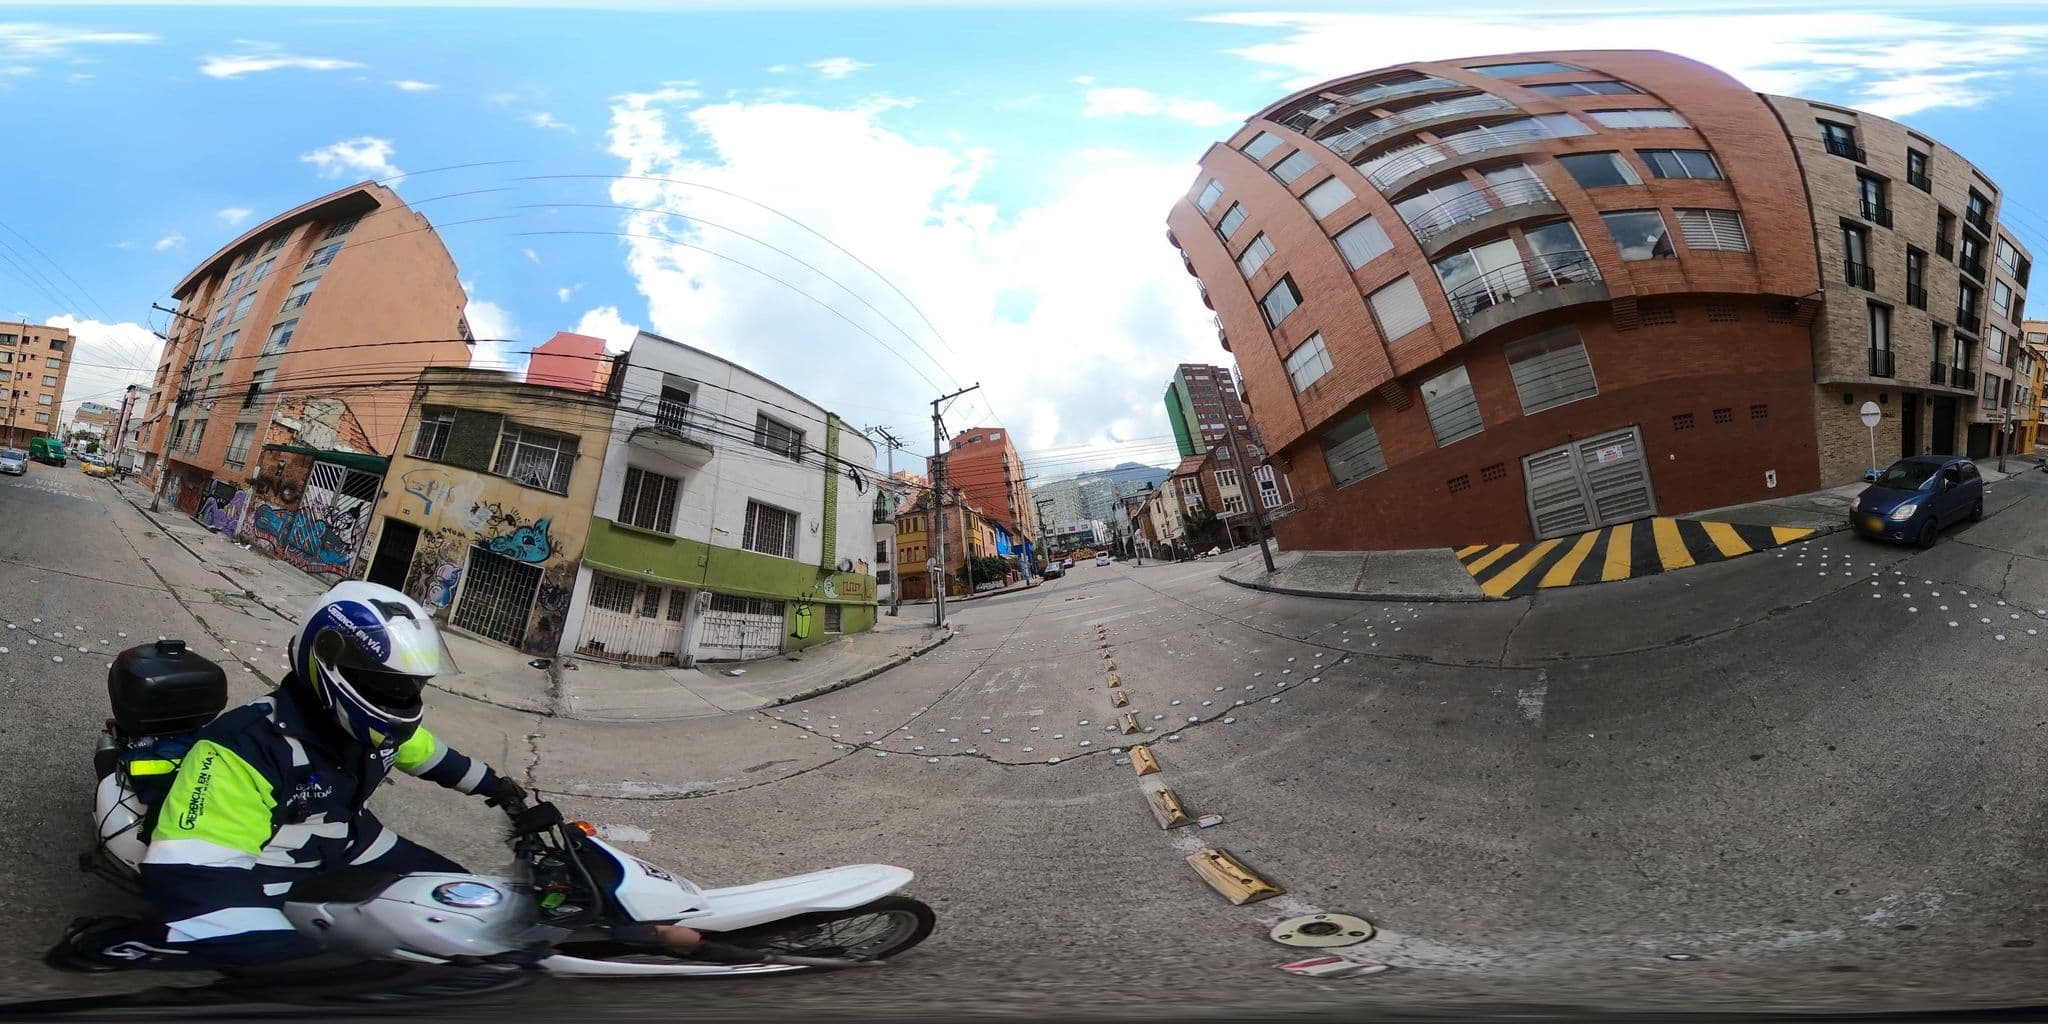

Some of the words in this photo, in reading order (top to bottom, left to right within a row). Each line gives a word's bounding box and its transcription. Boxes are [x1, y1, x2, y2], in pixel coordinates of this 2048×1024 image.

[356, 630, 369, 641] EN
[367, 638, 381, 653] VÍA
[202, 757, 214, 770] VÍA
[198, 772, 207, 784] EN
[179, 787, 203, 830] GERENCIA
